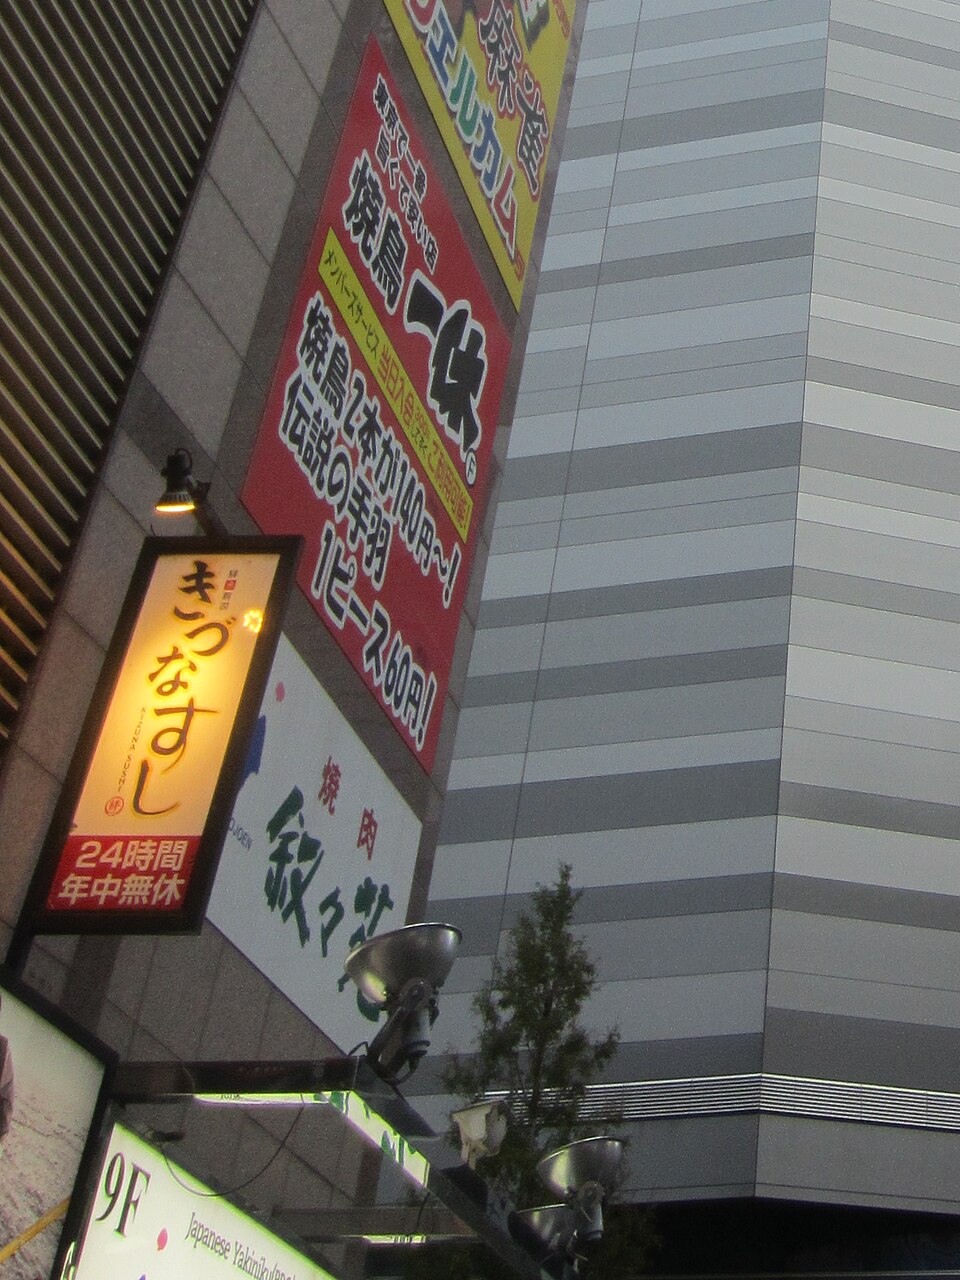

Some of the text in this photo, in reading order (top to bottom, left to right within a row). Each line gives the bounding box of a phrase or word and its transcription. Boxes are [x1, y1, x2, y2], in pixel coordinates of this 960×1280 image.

[375, 125, 438, 275] 旨くて安い店
[324, 243, 379, 359] メンバーズサービス
[376, 343, 415, 429] 当日入会
[342, 153, 407, 314] 焼鳥
[404, 268, 488, 462] 一休
[279, 373, 393, 590] 伝説の手羽
[133, 560, 236, 816] きづなすし
[311, 521, 438, 751] 1ピース60円!
[75, 839, 189, 871] 24時間
[318, 755, 379, 861] 焼肉
[58, 873, 187, 906] 年中無休
[95, 1152, 151, 1238] 9F
[185, 1212, 231, 1260] Japanese
